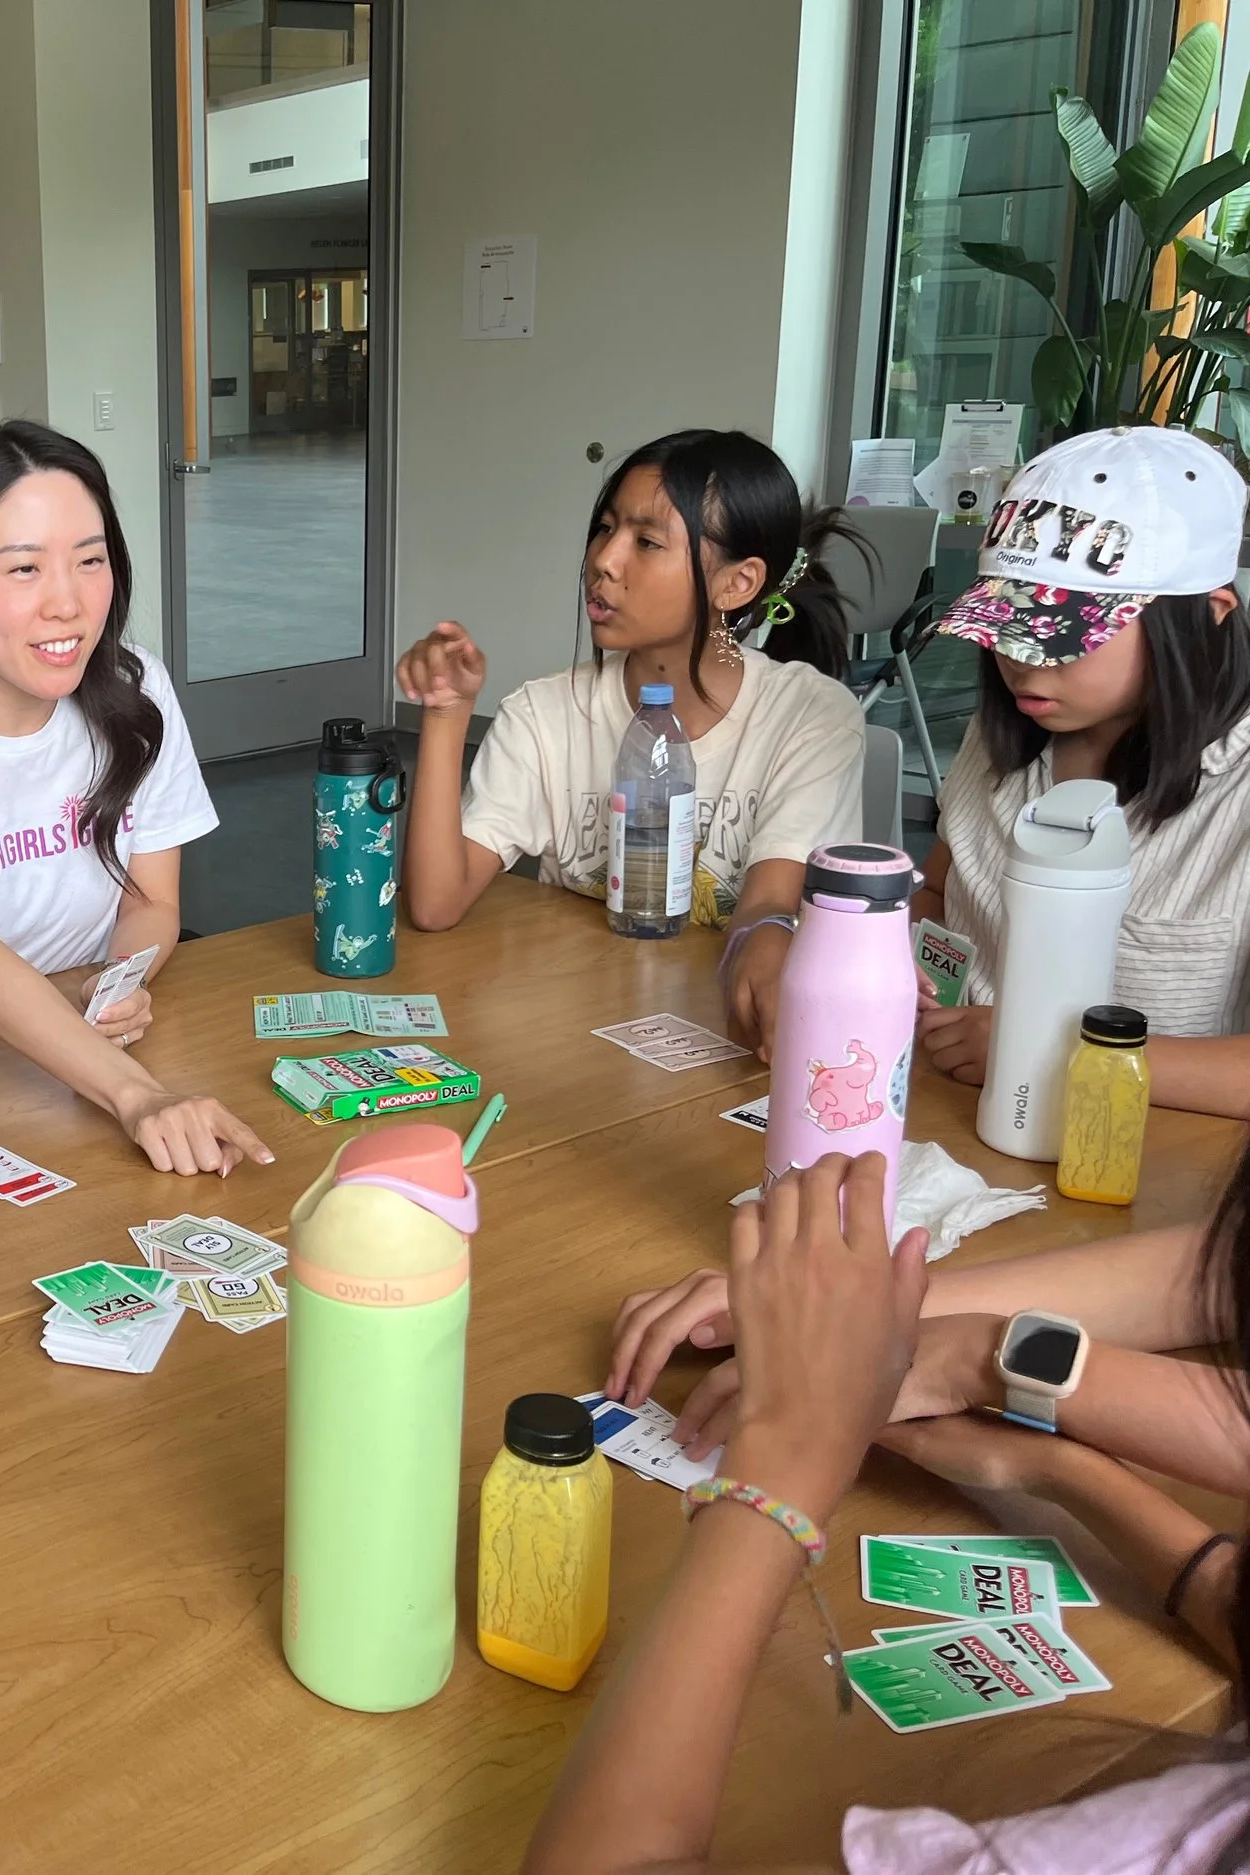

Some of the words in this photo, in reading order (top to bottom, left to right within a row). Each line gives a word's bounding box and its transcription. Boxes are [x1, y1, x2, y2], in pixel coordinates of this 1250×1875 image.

[984, 499, 1134, 577] OKYO
[996, 551, 1037, 567] Original
[921, 945, 959, 978] DEAL
[925, 936, 965, 962] MONOPOLY
[322, 1058, 374, 1088] MONOPOLY
[350, 1056, 396, 1082] DEAL
[379, 1091, 437, 1109] MONOPOLY
[442, 1083, 475, 1099] DEAL
[1014, 1085, 1029, 1130] owala
[222, 1282, 246, 1291] GO
[335, 1281, 404, 1303] owala
[83, 1293, 145, 1316] DEAL
[98, 1303, 153, 1325] MONOPOLY
[972, 1564, 1006, 1613] DEAL
[1011, 1569, 1029, 1614] MONOPOL
[963, 1638, 1029, 1694] MONOPOLY
[1018, 1625, 1075, 1682] MONOPOLY
[929, 1658, 949, 1676] CARD
[948, 1675, 968, 1694] GAME
[935, 1643, 1004, 1701] DEAL
